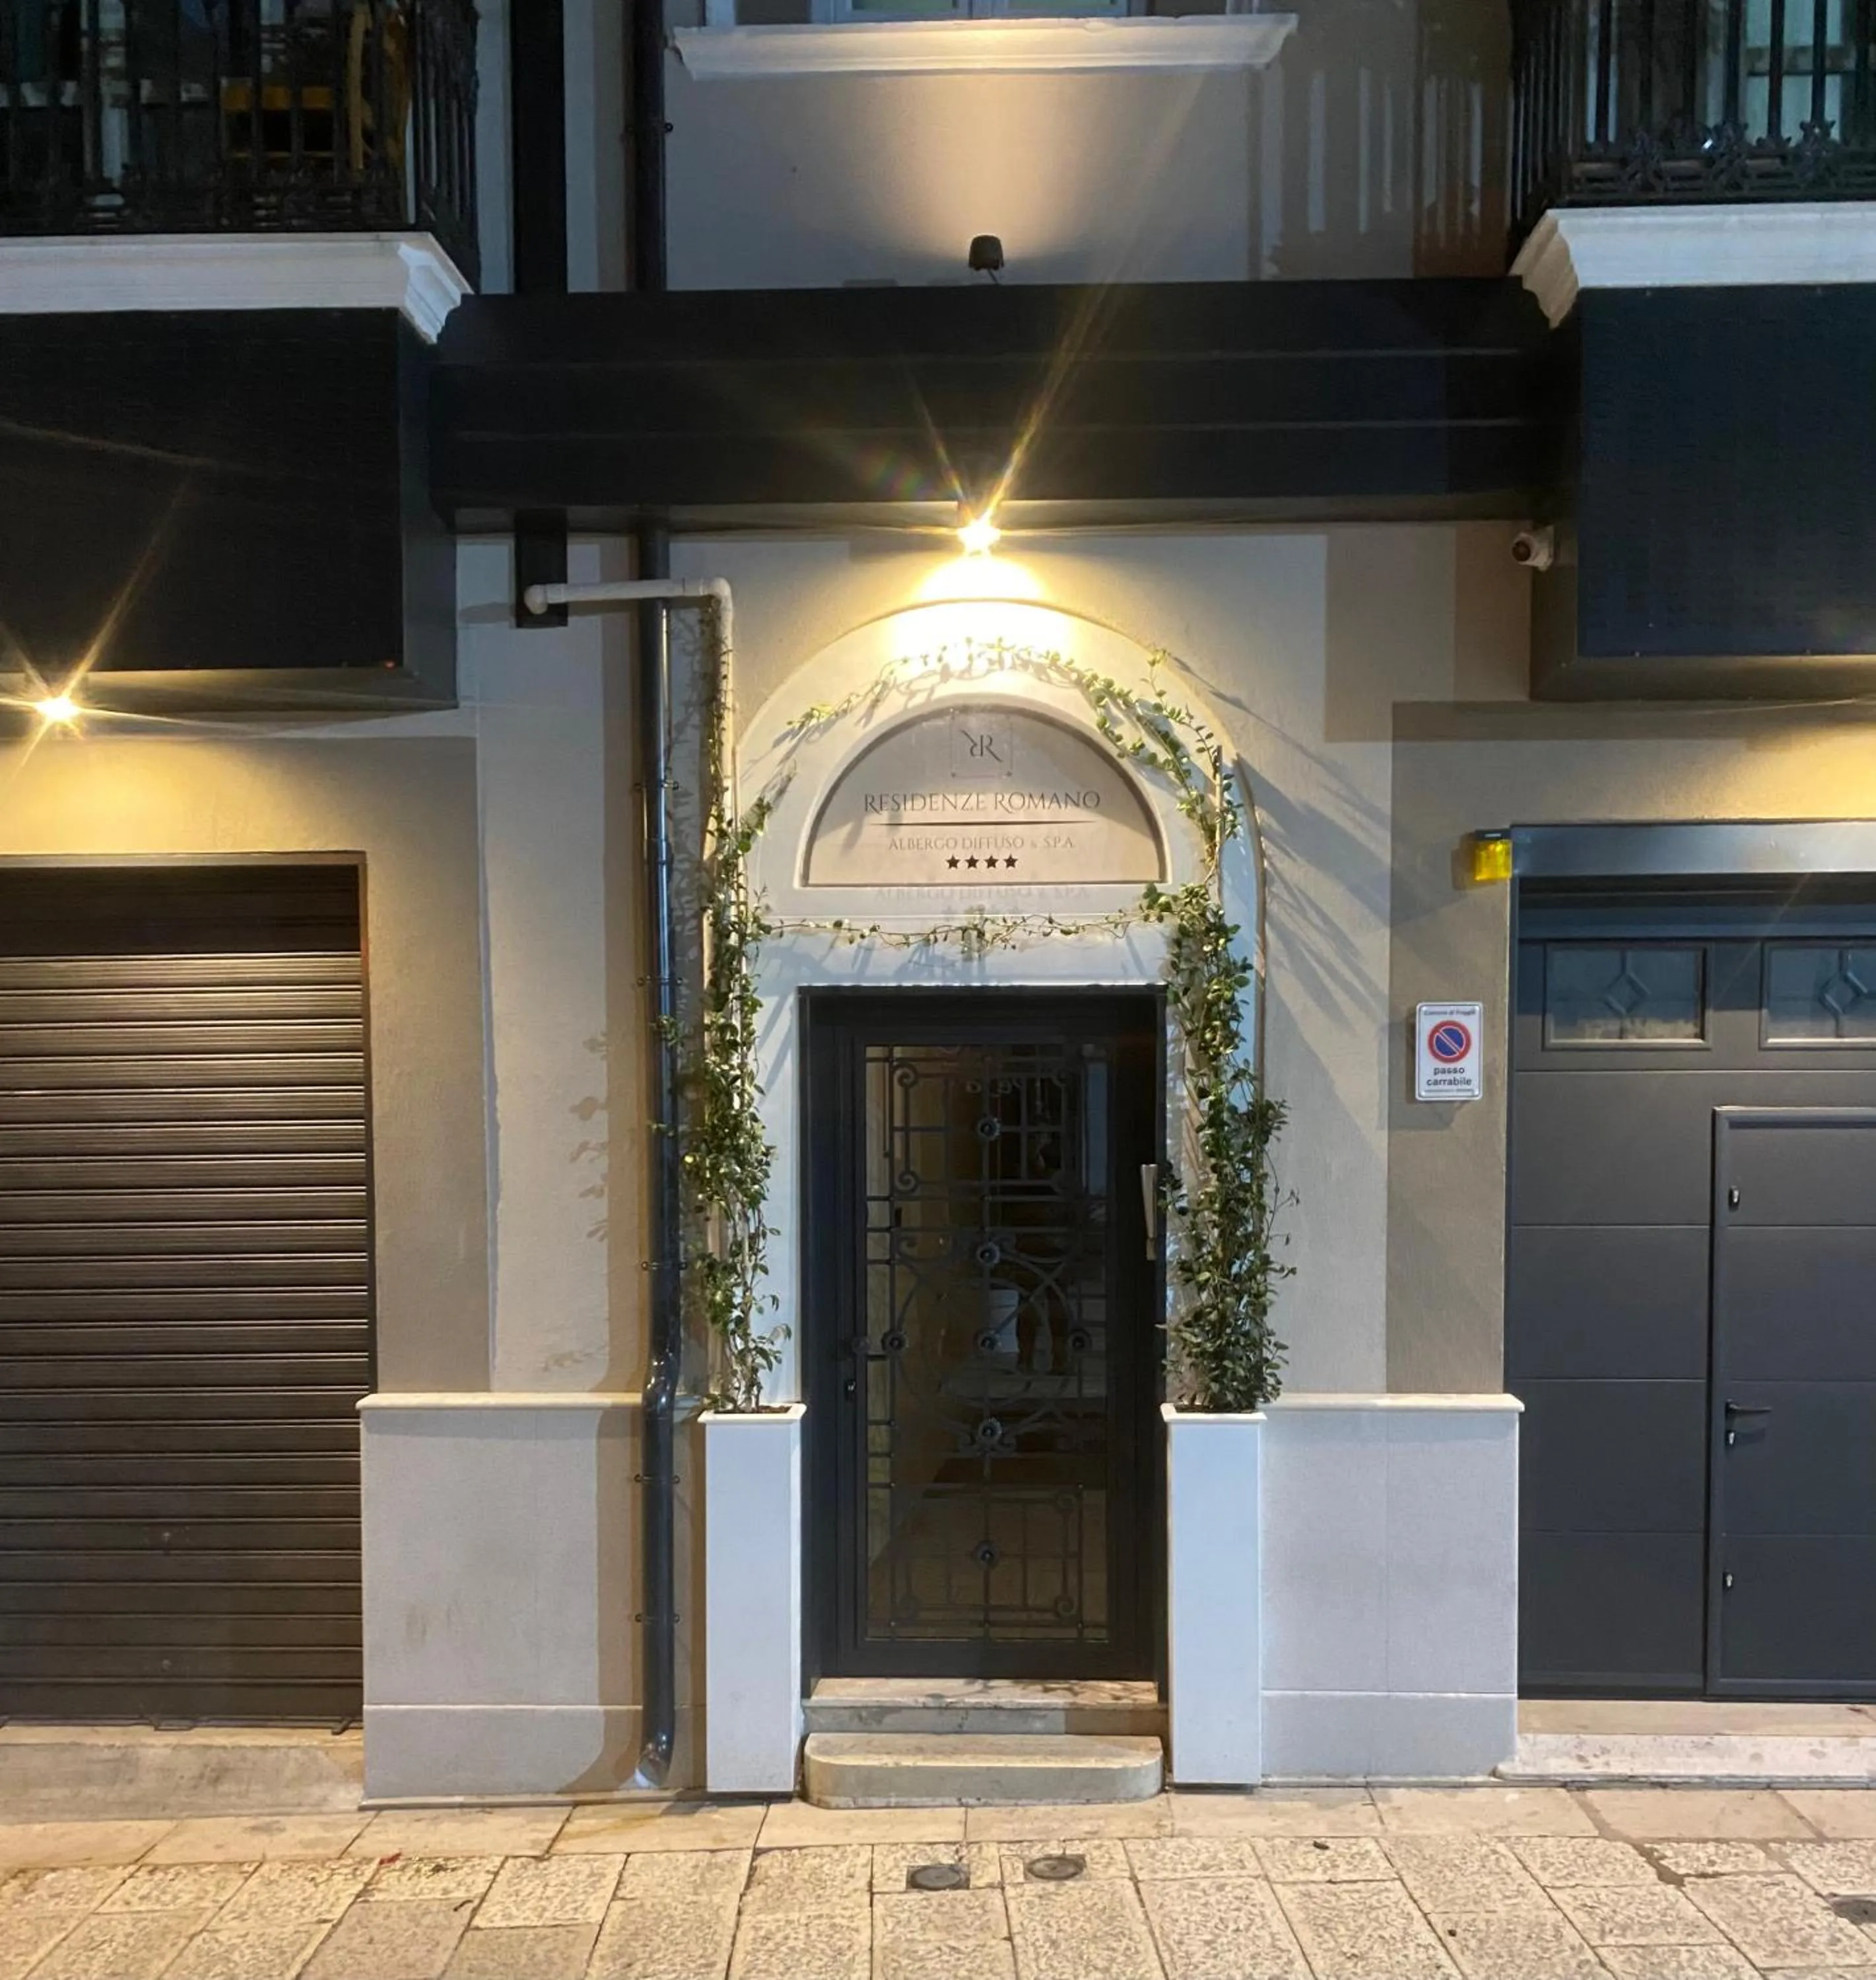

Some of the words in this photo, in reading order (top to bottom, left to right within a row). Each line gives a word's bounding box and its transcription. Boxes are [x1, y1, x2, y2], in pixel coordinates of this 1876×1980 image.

[865, 793, 988, 814] RESIDENZE
[994, 791, 1101, 814] ROMANO
[888, 836, 958, 851] ALBERGO
[962, 835, 1024, 850] DIFFUSO
[1434, 1067, 1465, 1076] passo
[1426, 1076, 1473, 1086] carrabile
